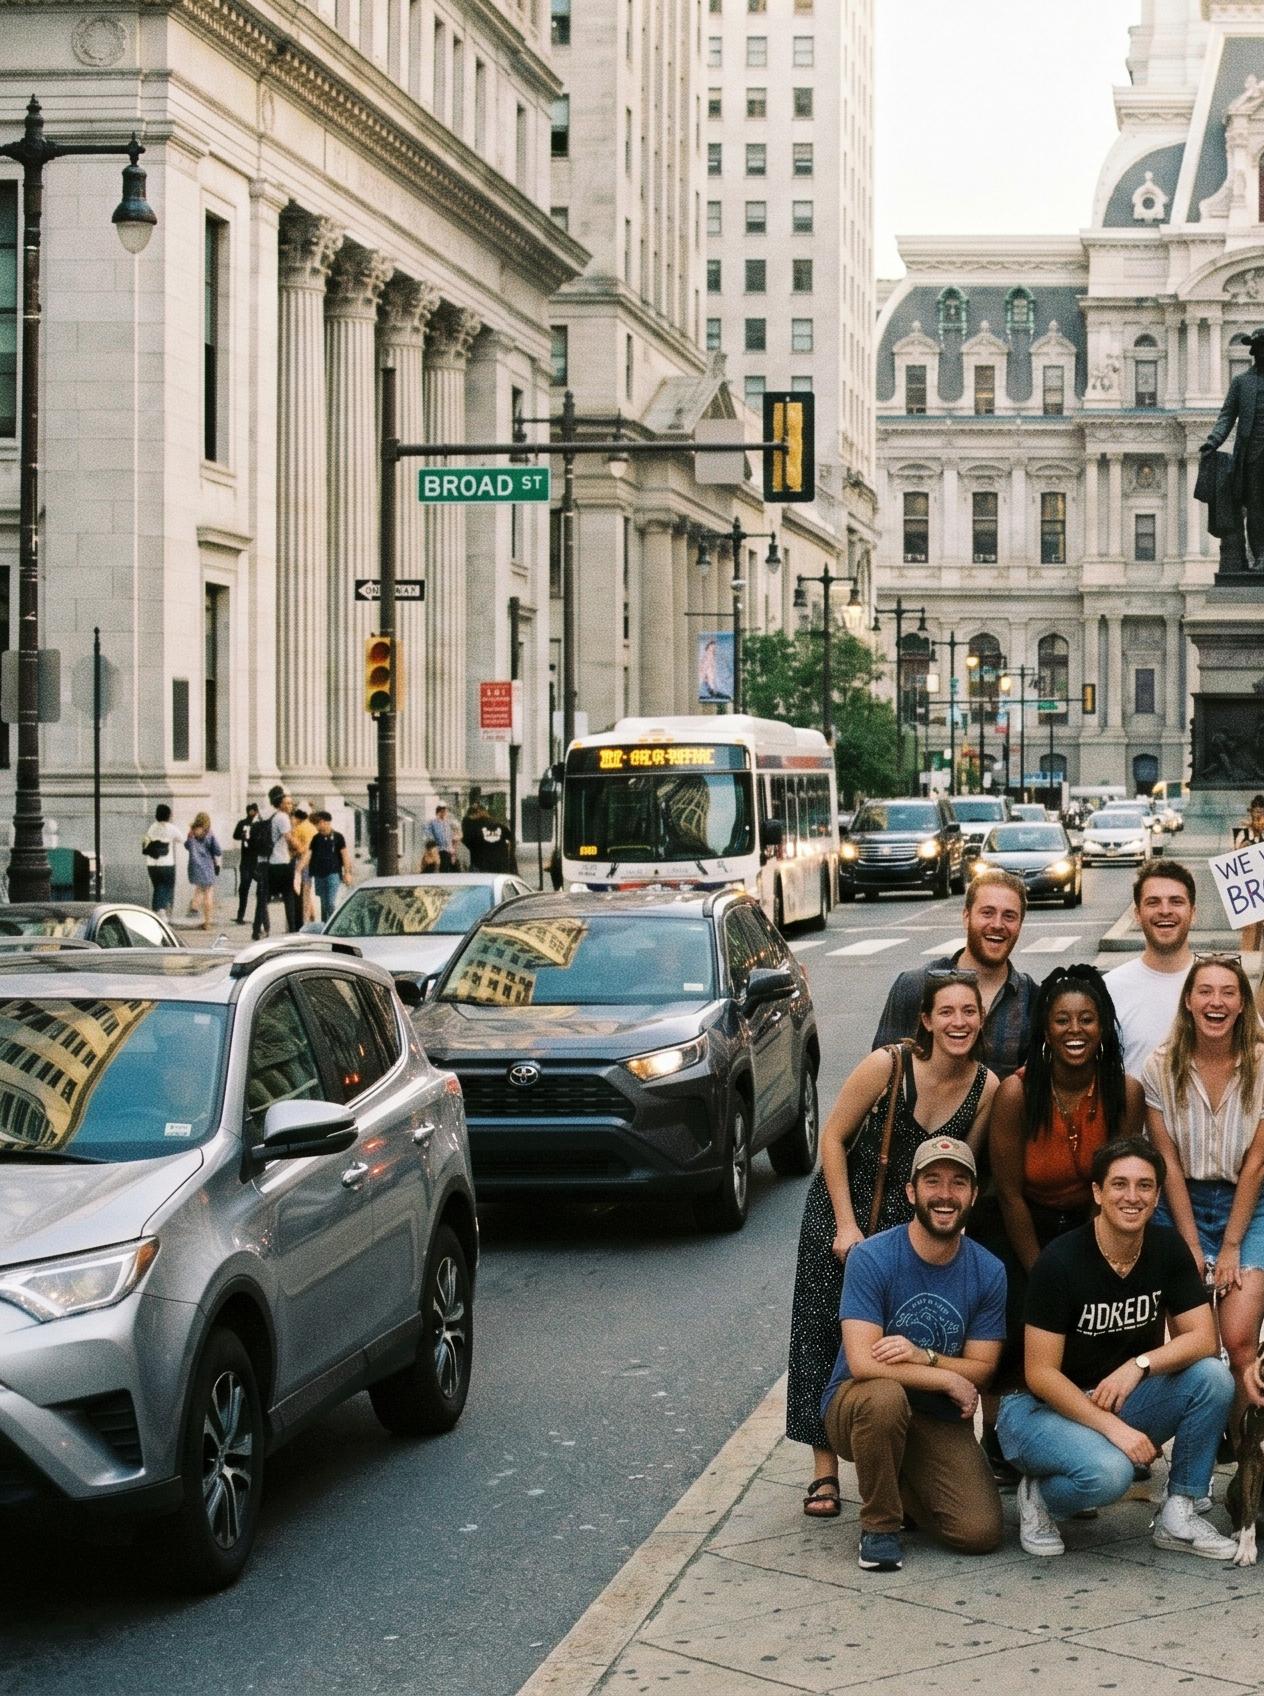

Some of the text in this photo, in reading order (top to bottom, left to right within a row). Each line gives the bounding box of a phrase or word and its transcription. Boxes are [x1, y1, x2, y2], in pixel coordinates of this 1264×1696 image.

[424, 475, 543, 497] BROAD ST
[1215, 852, 1253, 880] WE
